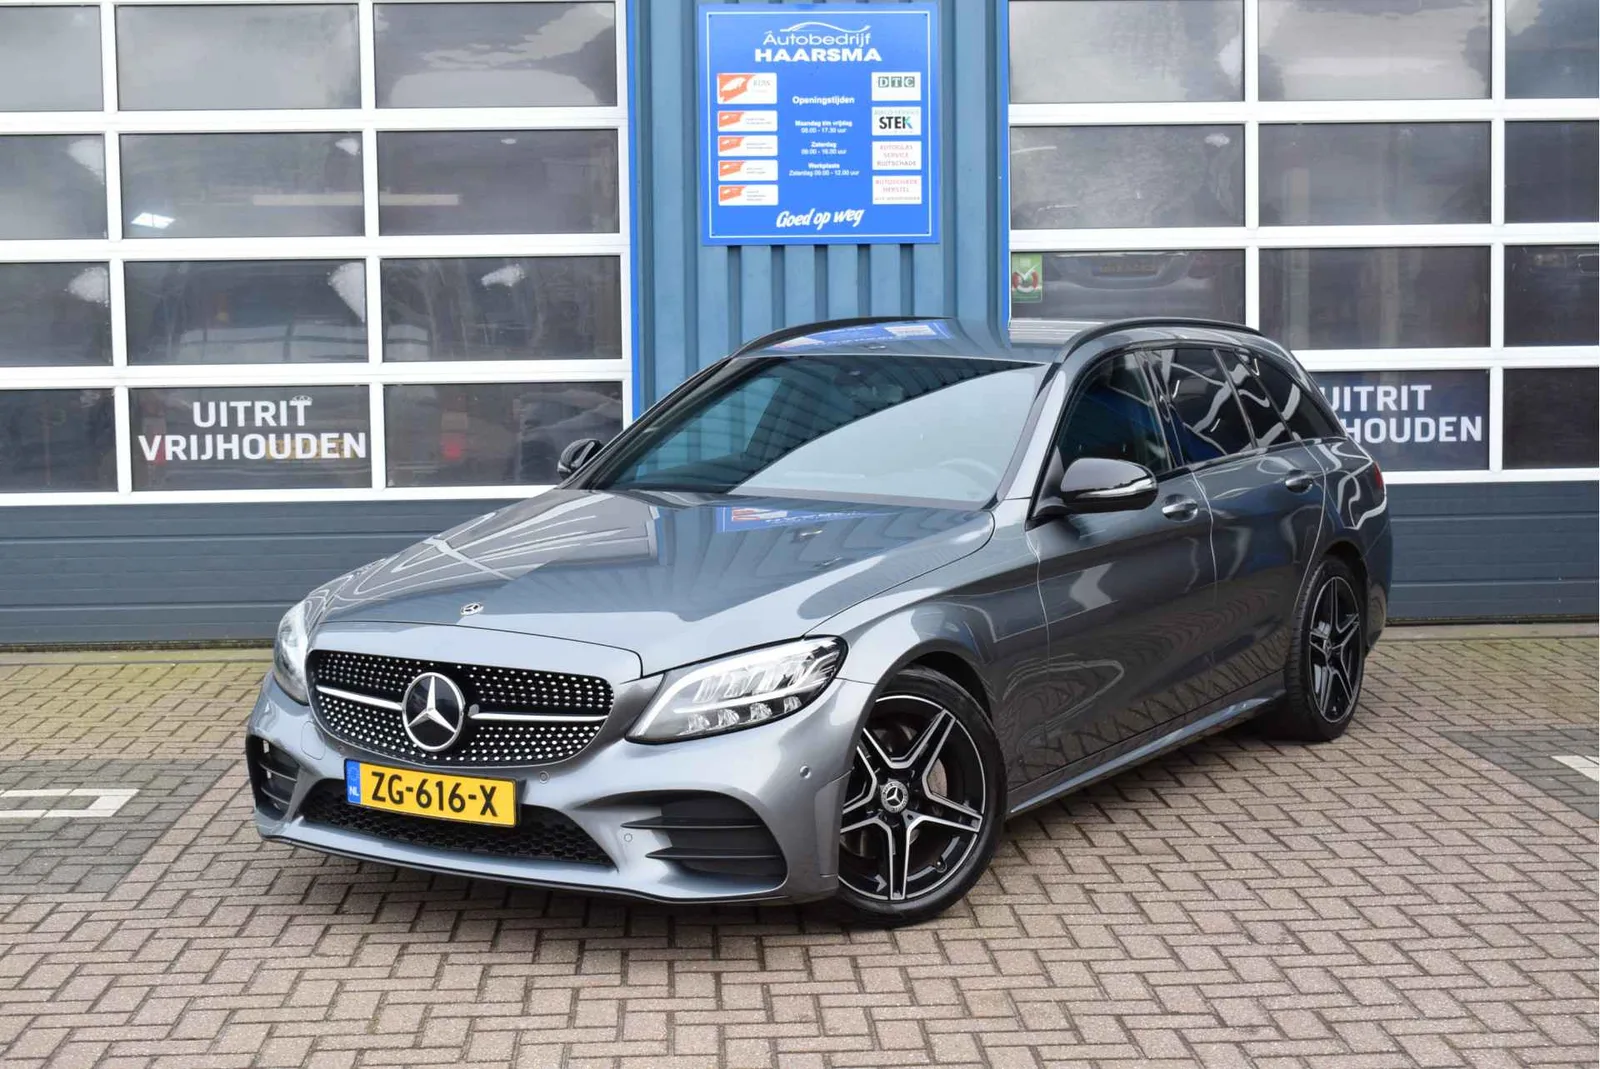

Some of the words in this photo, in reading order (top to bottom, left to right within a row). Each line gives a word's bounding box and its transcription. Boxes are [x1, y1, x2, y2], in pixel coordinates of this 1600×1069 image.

[763, 32, 871, 47] Autobedrijf
[755, 48, 882, 62] HAARSMA
[878, 76, 915, 88] DTC
[792, 95, 855, 106] Openingstijden
[832, 120, 853, 128] vrijdag
[879, 116, 913, 129] STEK
[776, 208, 815, 228] Goed
[813, 213, 830, 230] op
[833, 208, 865, 227] weg
[1320, 385, 1432, 412] UITRIT
[193, 400, 312, 428] UITRIT
[1340, 416, 1482, 444] HOUDEN
[138, 432, 366, 461] VRIJHOUDEN
[349, 786, 360, 797] NL
[371, 771, 498, 817] ZG-616-X
